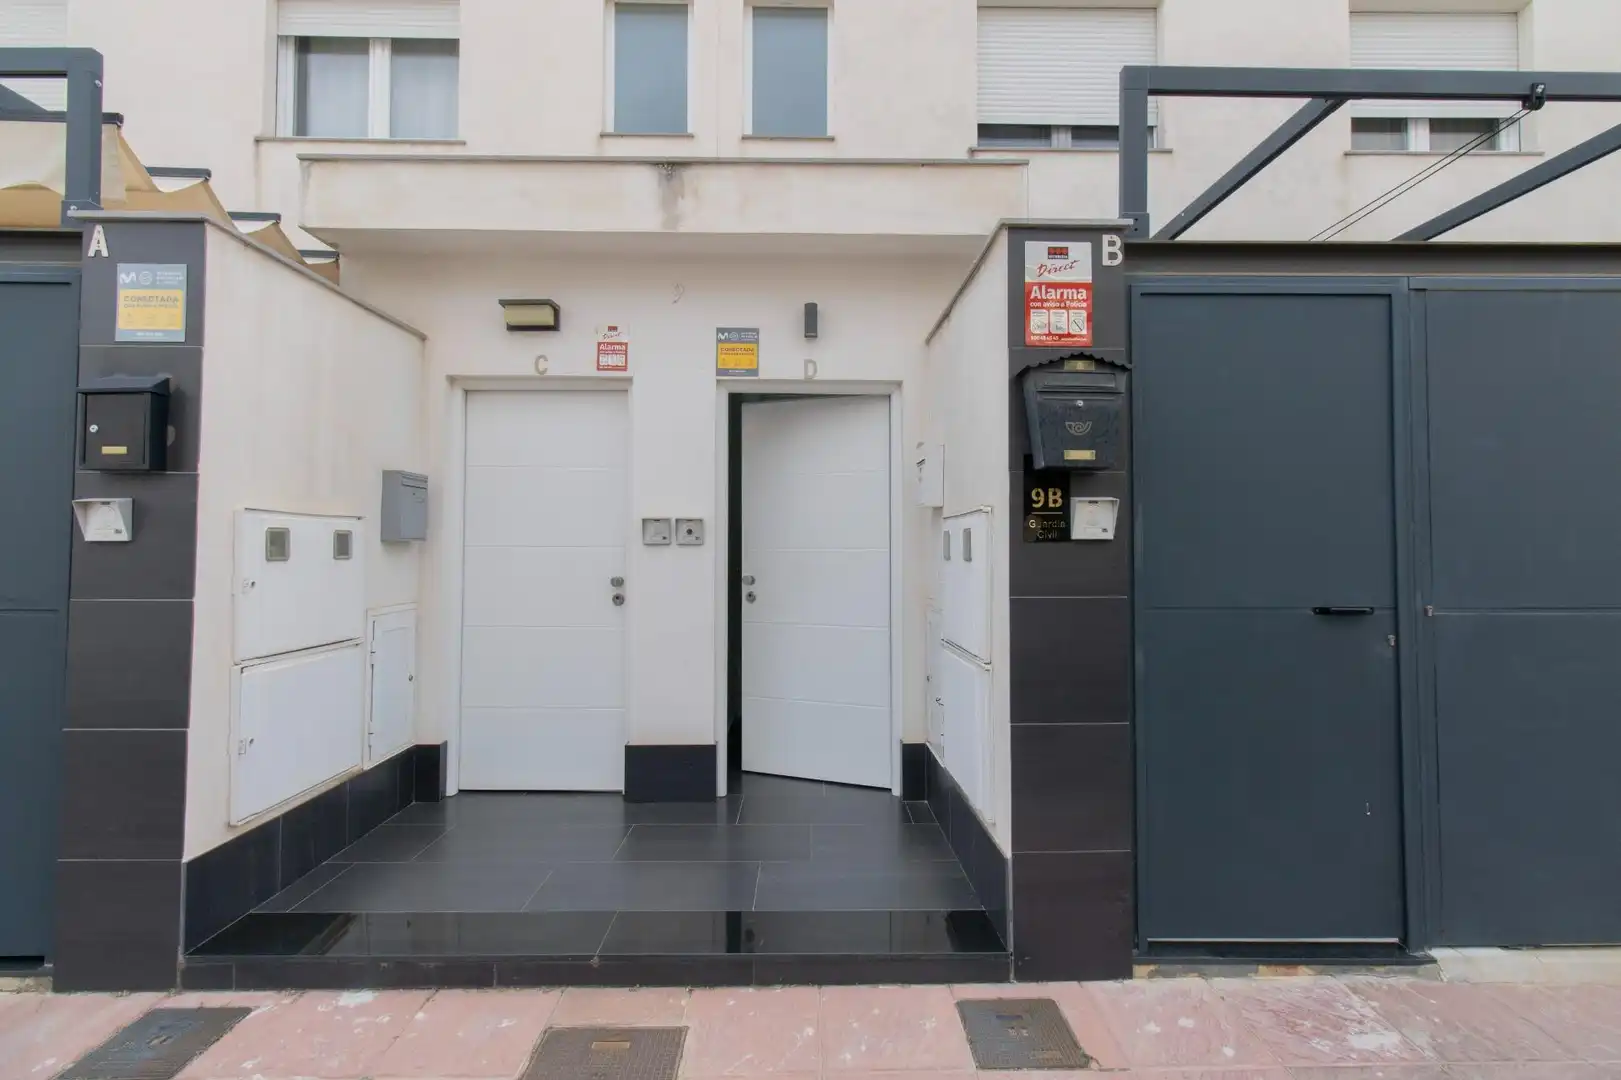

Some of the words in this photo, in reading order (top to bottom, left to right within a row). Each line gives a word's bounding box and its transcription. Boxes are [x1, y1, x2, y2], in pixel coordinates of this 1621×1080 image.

[87, 224, 109, 257] A
[1102, 234, 1123, 266] B
[1036, 260, 1080, 277] Direct
[1030, 284, 1087, 300] Alarma
[600, 343, 626, 351] Alarma
[534, 354, 548, 375] C
[804, 359, 818, 380] D
[1031, 487, 1063, 508] 9B
